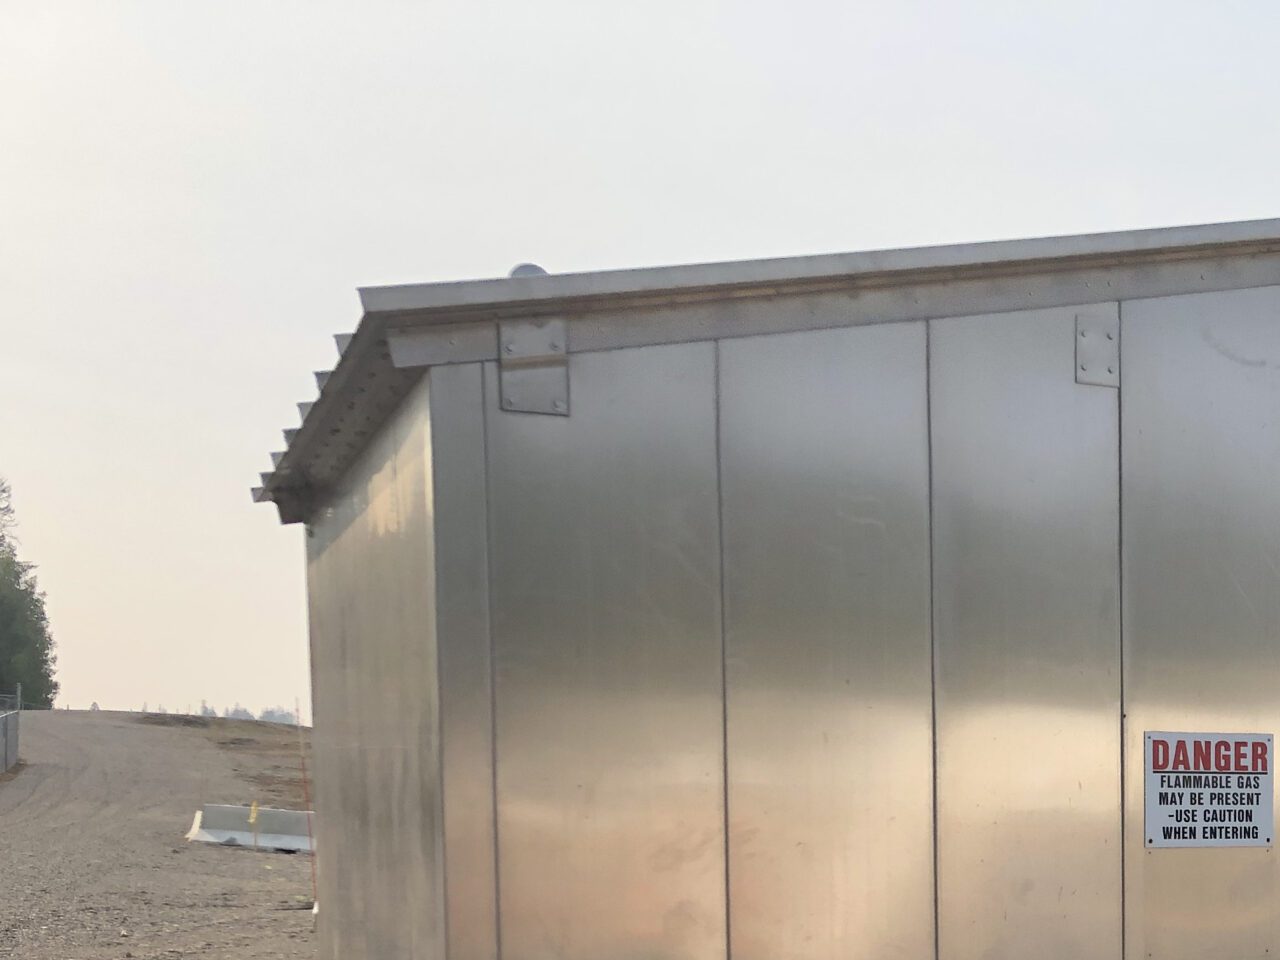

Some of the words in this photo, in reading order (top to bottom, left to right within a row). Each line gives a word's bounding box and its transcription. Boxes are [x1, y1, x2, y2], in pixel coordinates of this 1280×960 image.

[1153, 740, 1267, 771] DANGER
[1161, 775, 1231, 789] FLAMMABLE
[1237, 776, 1259, 789] GAS
[1159, 792, 1184, 805] MAY
[1190, 792, 1204, 805] BE
[1210, 793, 1261, 806] PRESENT
[1169, 810, 1197, 822] -USE
[1204, 810, 1252, 822] CAUTION
[1163, 826, 1196, 839] WHEN
[1203, 826, 1258, 839] ENTERING
